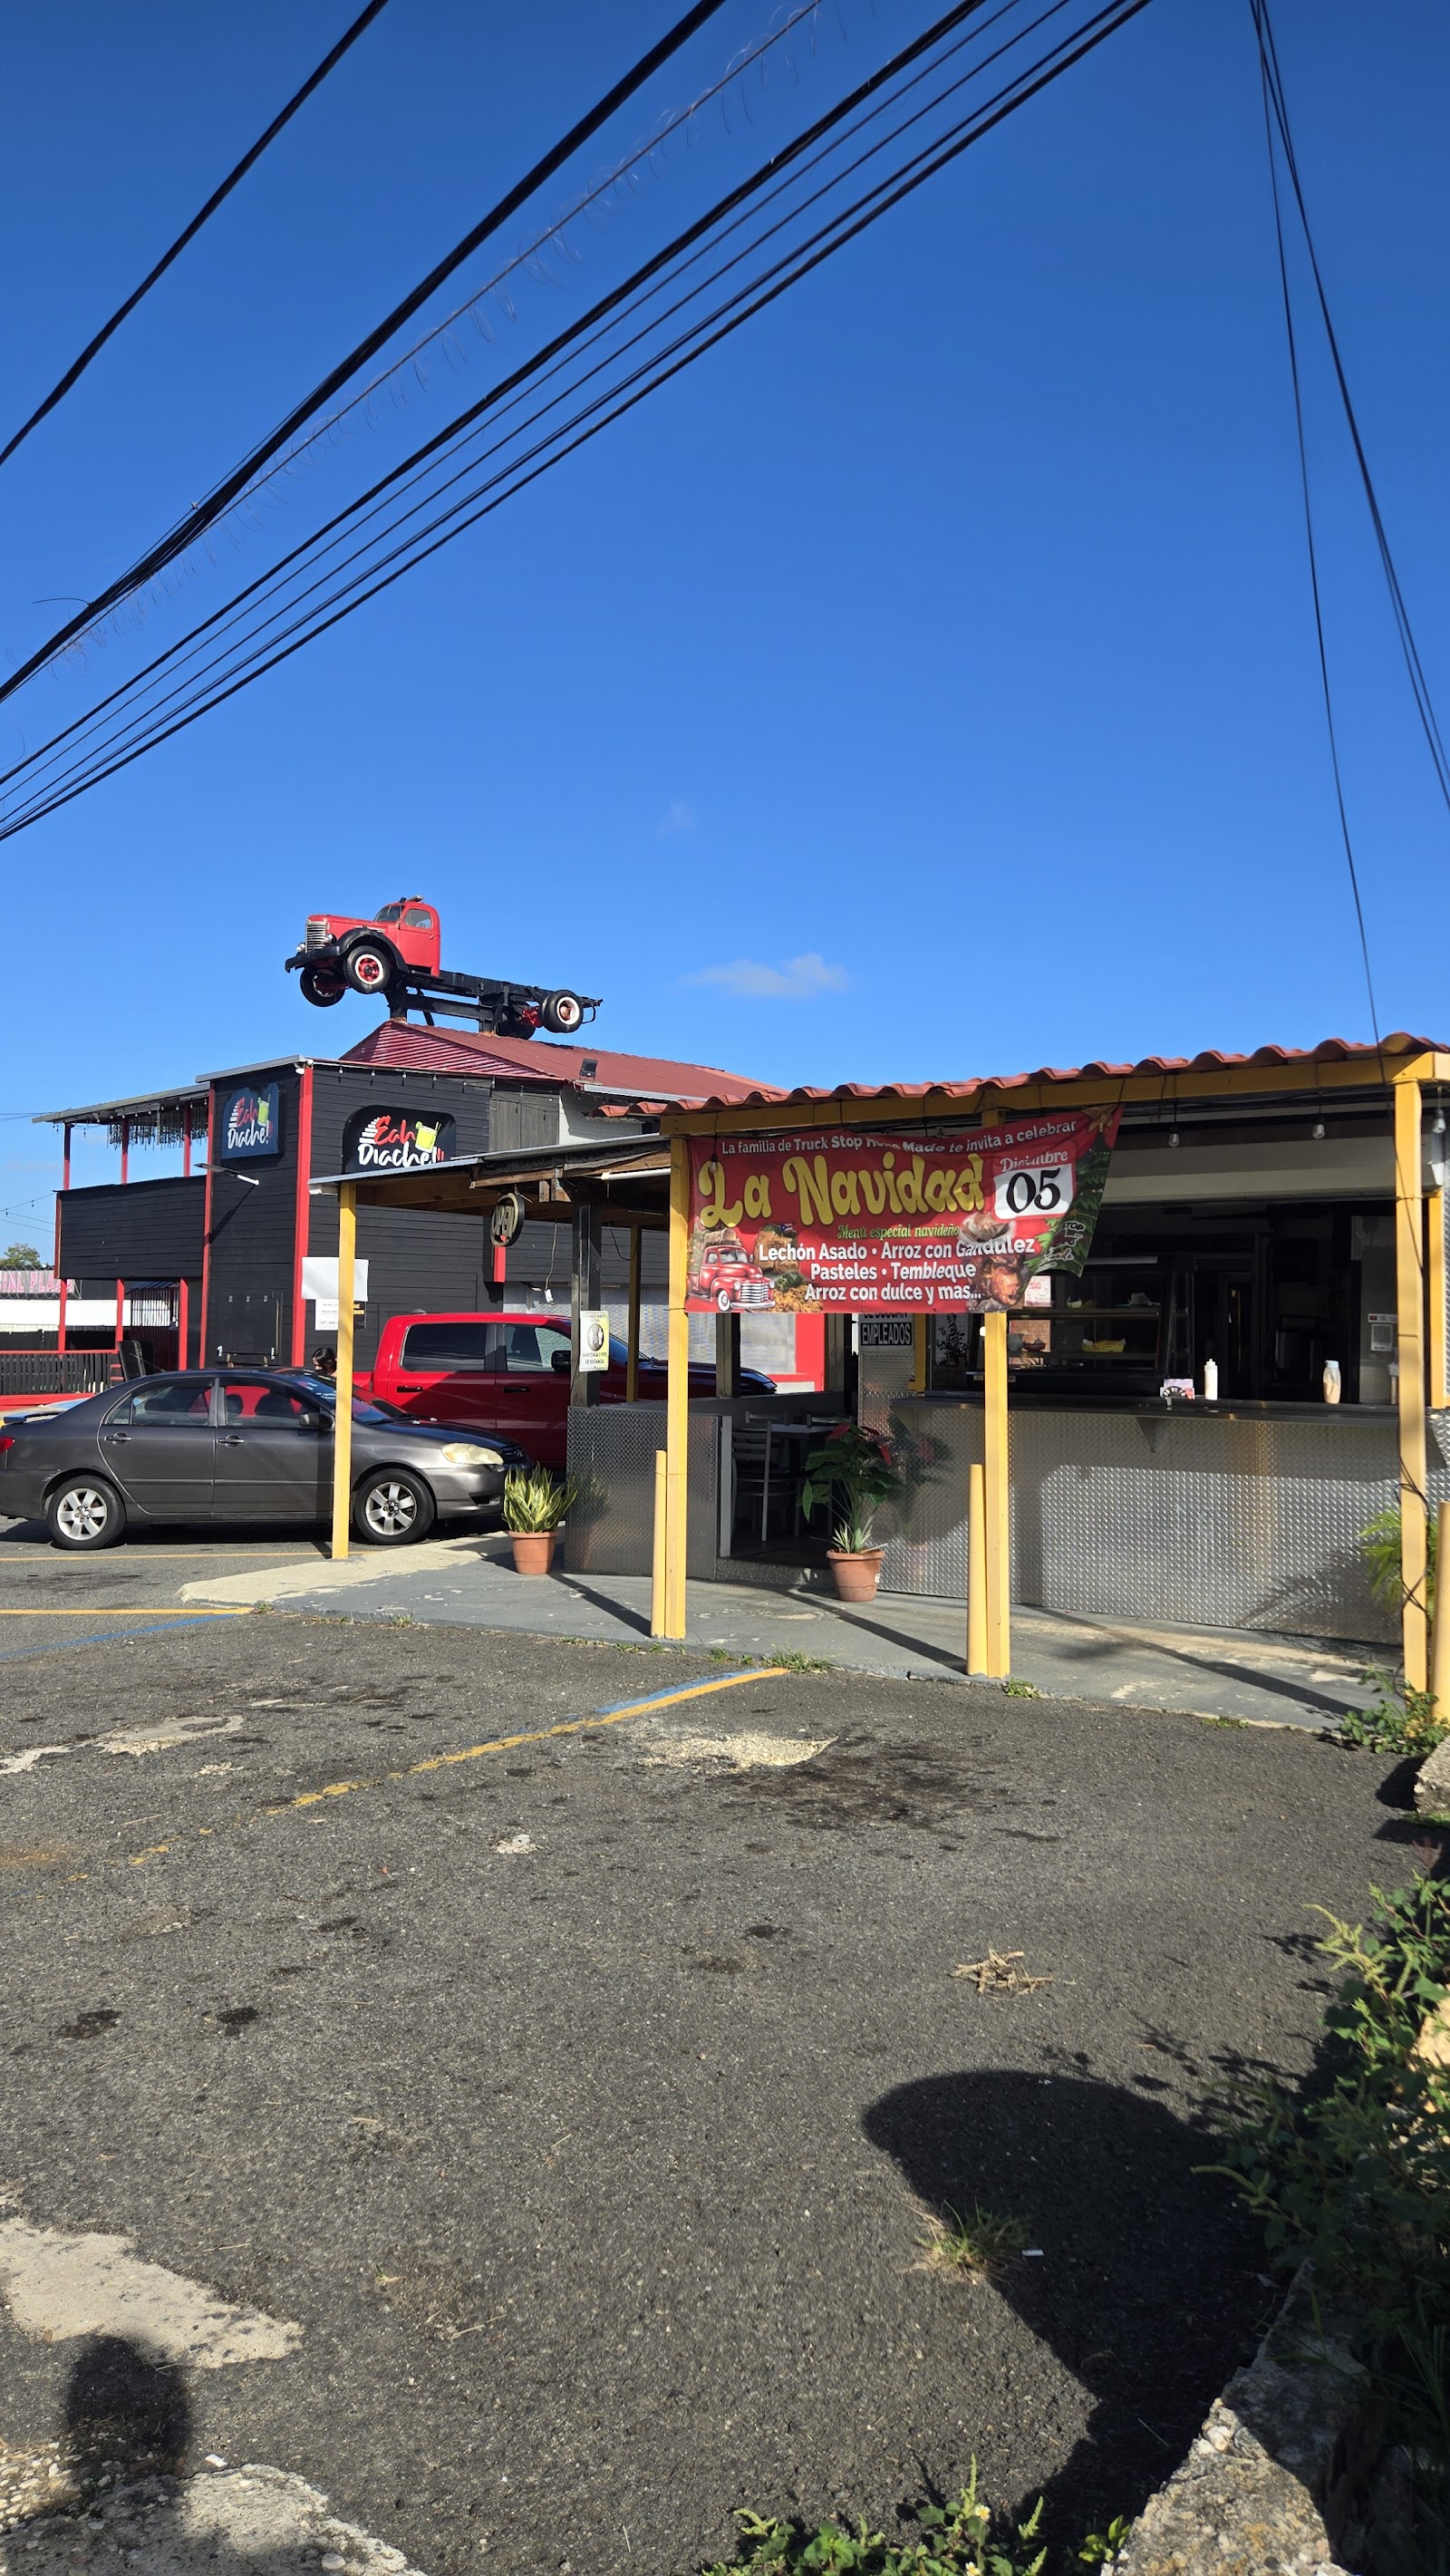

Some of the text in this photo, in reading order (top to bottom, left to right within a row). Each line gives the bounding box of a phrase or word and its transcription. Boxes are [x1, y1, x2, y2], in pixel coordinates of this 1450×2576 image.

[374, 1115, 416, 1146] Eah
[722, 1142, 735, 1155] La
[738, 1140, 776, 1154] familia
[778, 1138, 791, 1152] de
[794, 1138, 828, 1151] Truck
[831, 1135, 863, 1150] Stop
[949, 1143, 963, 1153] te
[966, 1135, 1001, 1151] invita
[1005, 1133, 1014, 1145] a
[1017, 1120, 1078, 1141] celebrar
[699, 1153, 984, 1228] La Navidad
[1006, 1167, 1060, 1214] 05
[837, 1224, 960, 1241] Menú especial navideño
[759, 1243, 816, 1261] Lechón
[818, 1242, 867, 1260] Asado
[881, 1242, 922, 1260] Arroz
[924, 1244, 952, 1258] con
[810, 1261, 977, 1283] Pasteles Tembleque
[805, 1283, 846, 1301] Arroz
[849, 1286, 878, 1301] con
[881, 1283, 923, 1301] dulce
[925, 1287, 934, 1305] y
[862, 1323, 911, 1344] EMPLEADOS
